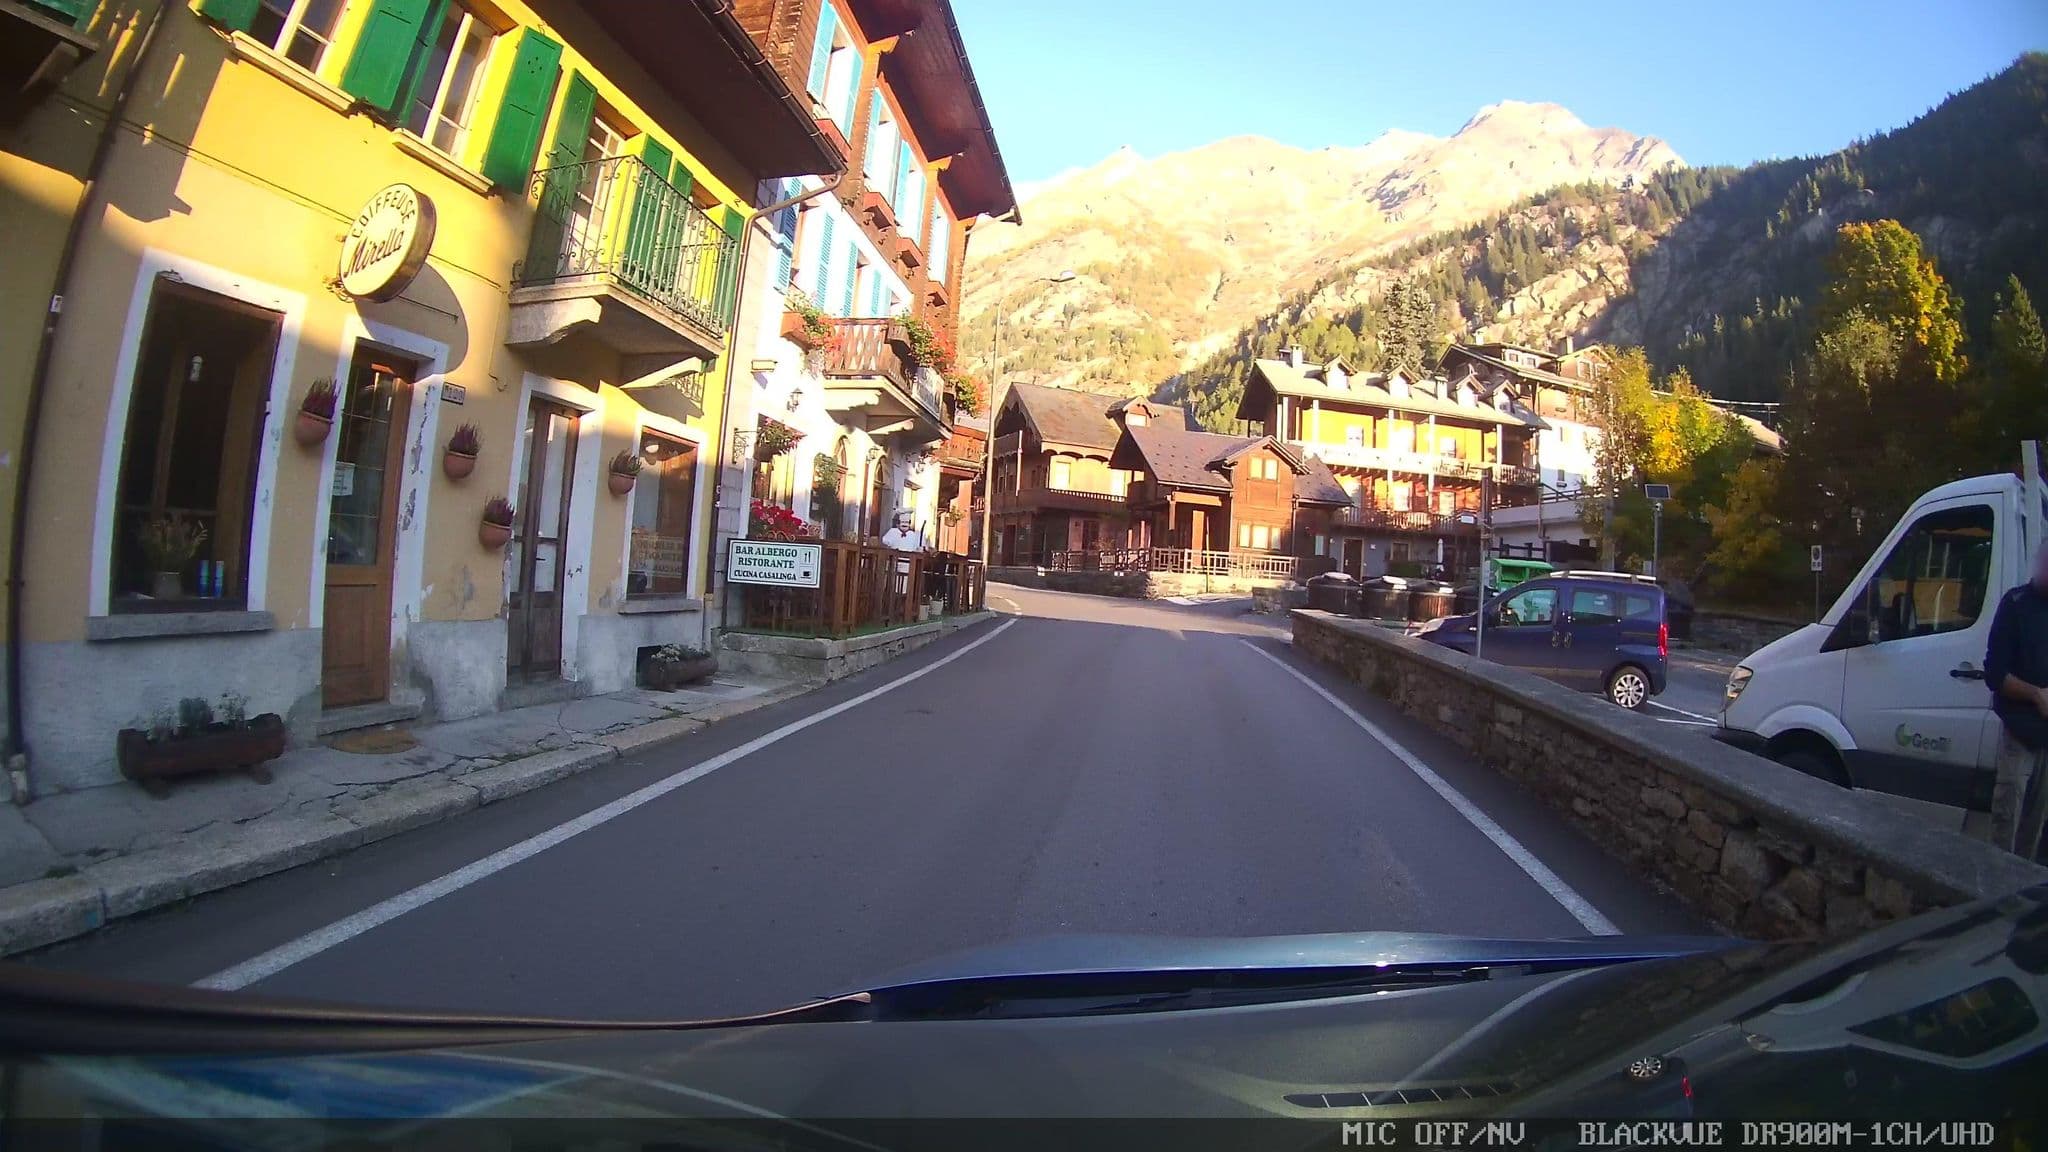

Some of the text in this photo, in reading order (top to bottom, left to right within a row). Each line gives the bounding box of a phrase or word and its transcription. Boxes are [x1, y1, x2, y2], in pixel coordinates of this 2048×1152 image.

[352, 190, 415, 238] COIFFEUSE
[343, 228, 405, 278] Mirella
[735, 546, 798, 558] BAR ALBERGO
[738, 557, 795, 569] RISTORANTE
[734, 569, 797, 581] CUCINA CASALINGA
